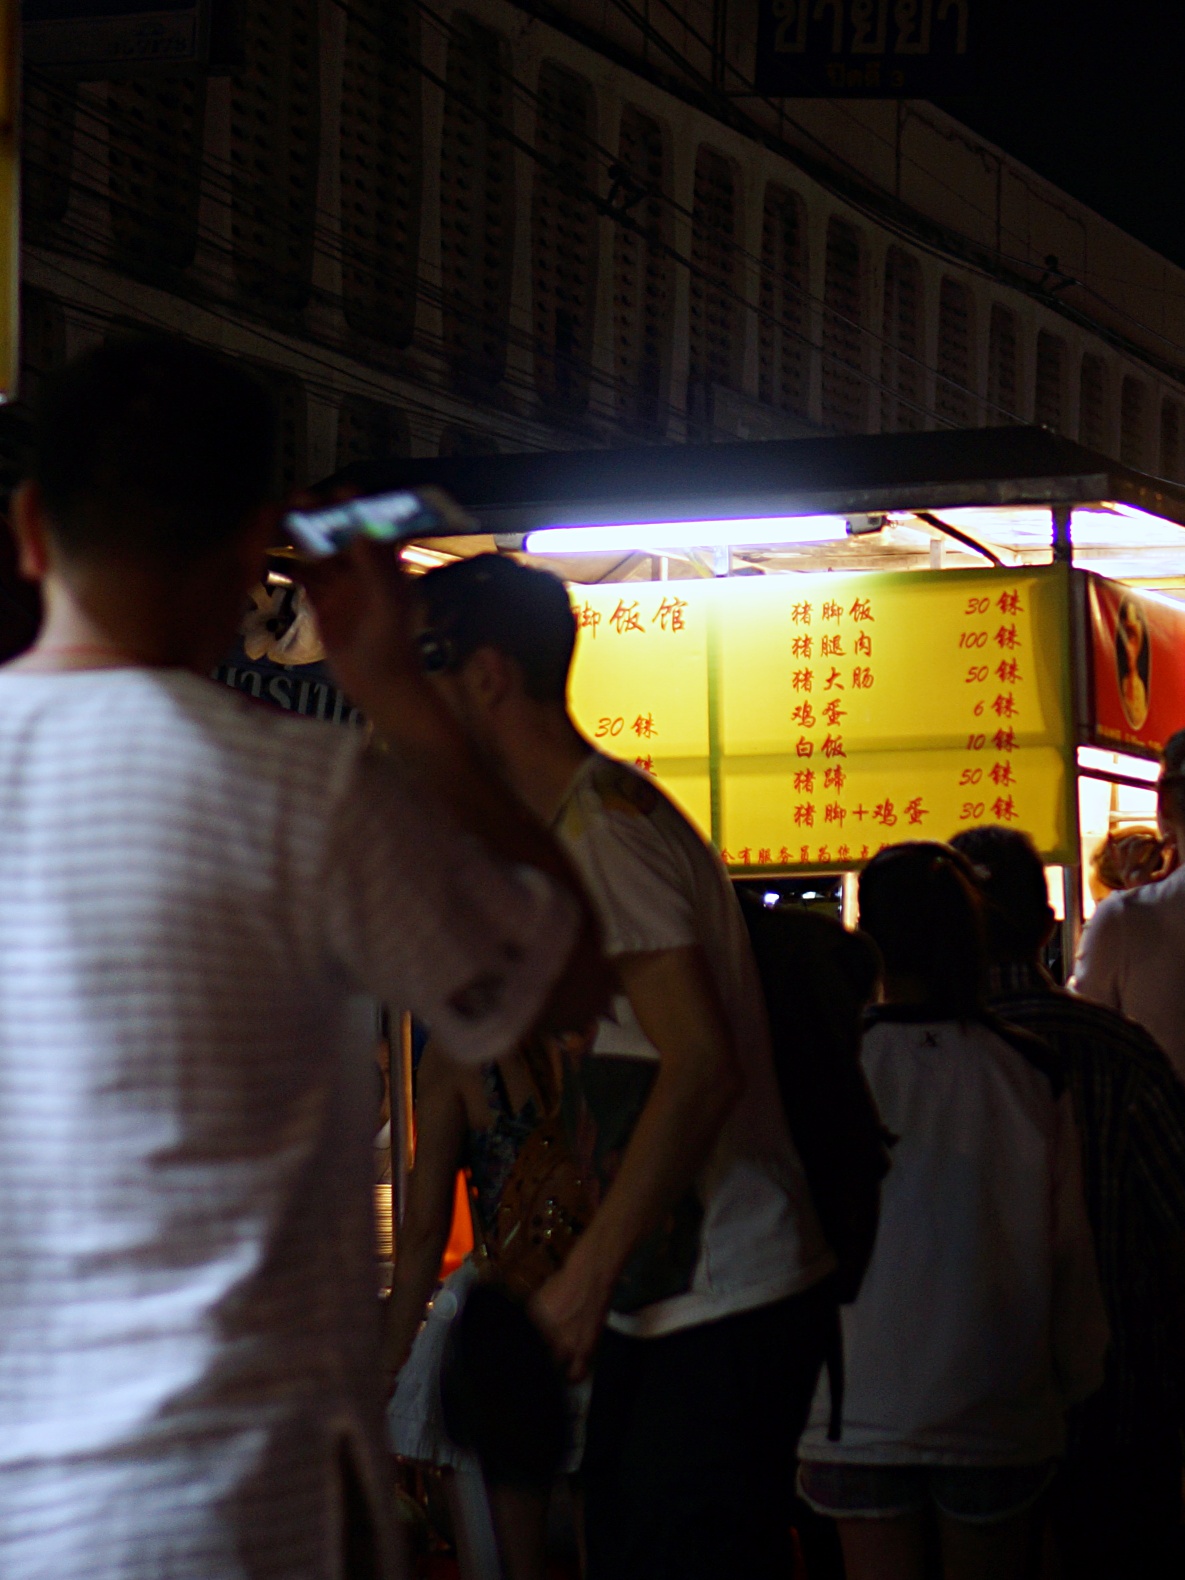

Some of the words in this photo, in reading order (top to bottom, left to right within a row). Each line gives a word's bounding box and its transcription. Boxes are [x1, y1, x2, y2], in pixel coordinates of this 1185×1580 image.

[792, 599, 875, 628] 猪脚饭
[964, 597, 990, 616] 30
[792, 631, 872, 659] 猪腿肉
[958, 631, 988, 649] 100
[792, 665, 874, 693] 猪大肠
[965, 665, 989, 683] 50
[594, 716, 625, 738] 30
[792, 698, 847, 729] 鸡蛋
[973, 701, 984, 717] 6
[796, 733, 847, 759] 白饭
[967, 733, 986, 751] 10
[793, 765, 845, 795] 猪蹄
[959, 768, 983, 786] 50
[959, 801, 985, 820] 30
[722, 843, 892, 867] 有服务员为您点
